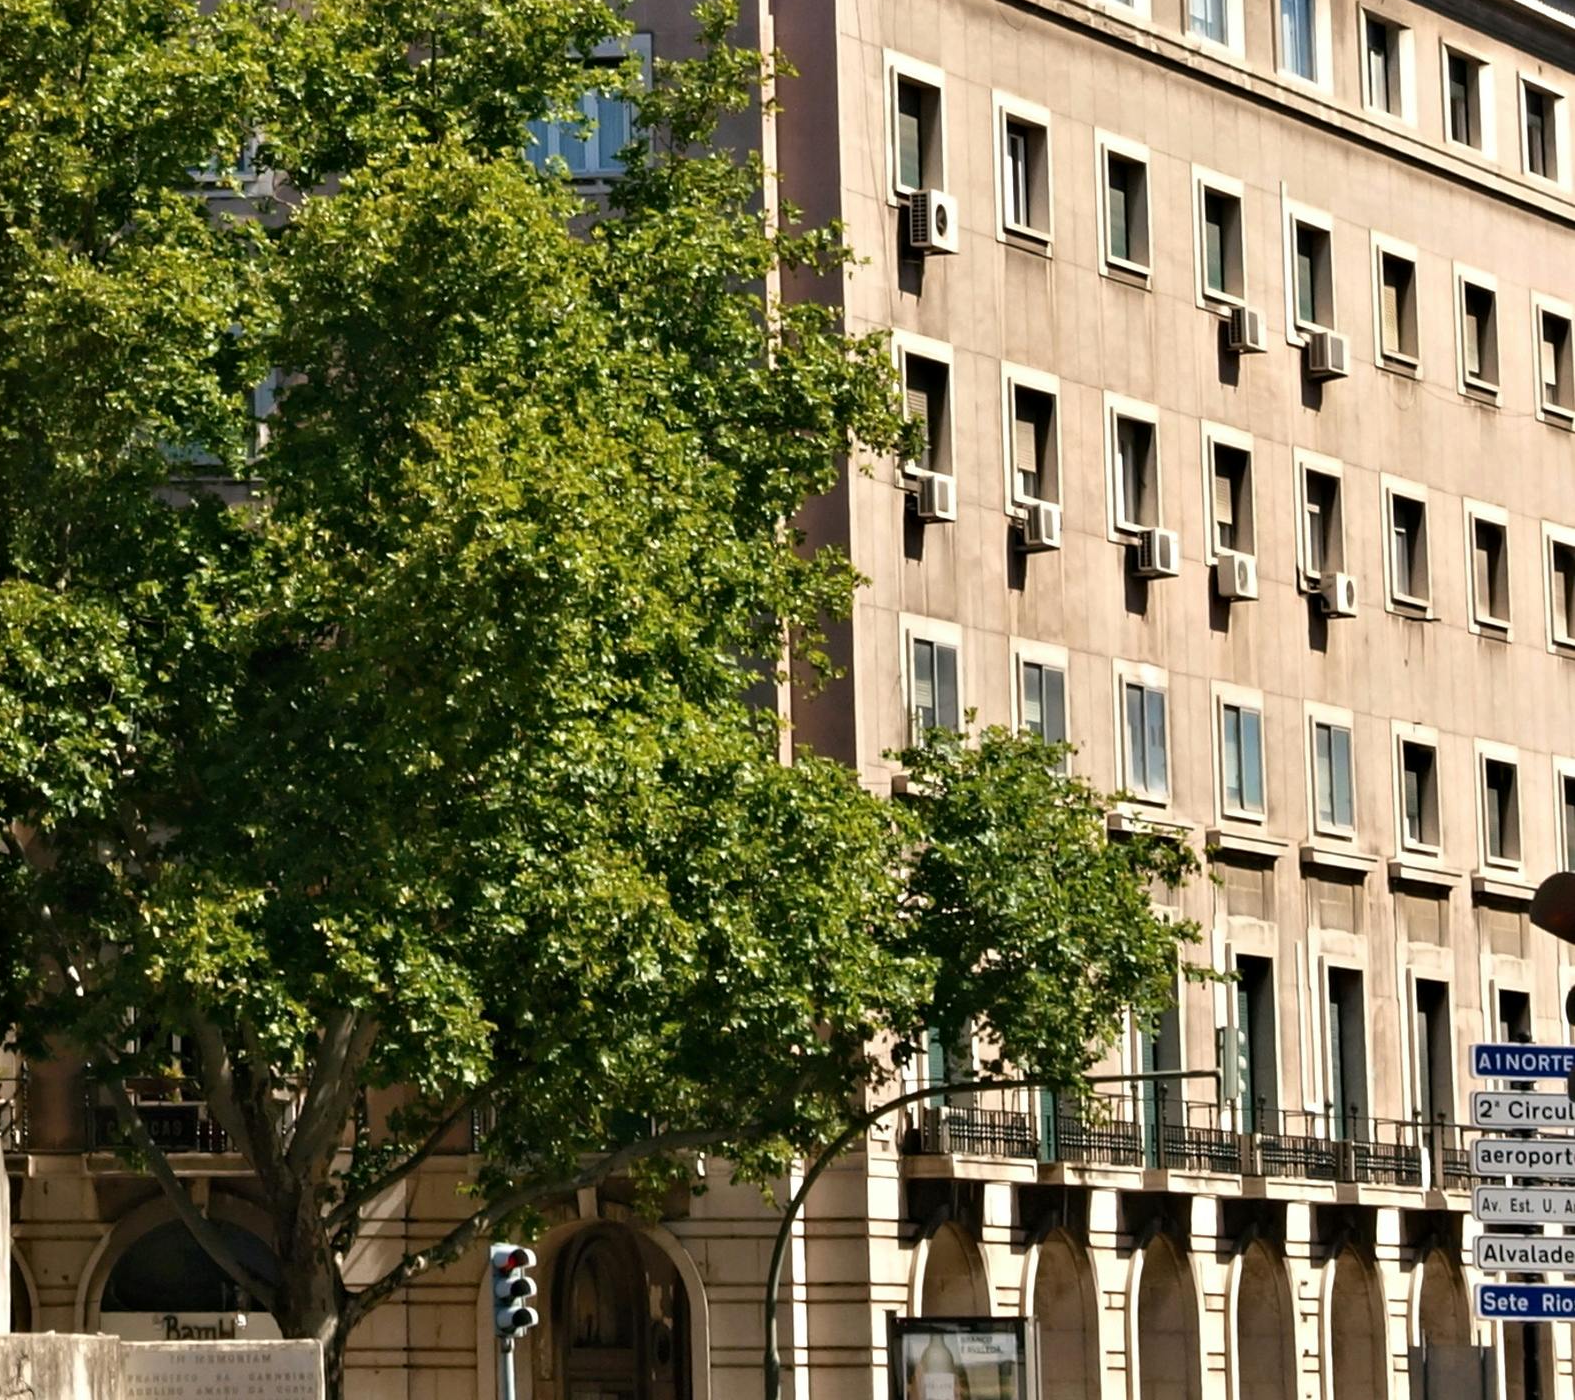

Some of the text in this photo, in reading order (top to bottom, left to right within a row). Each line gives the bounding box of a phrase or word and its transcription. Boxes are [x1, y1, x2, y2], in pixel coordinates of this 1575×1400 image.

[1480, 1147, 1575, 1168] aeroport
[1481, 1197, 1502, 1213] Av.
[1509, 1198, 1535, 1214] Est.
[1483, 1243, 1575, 1264] Alvalade
[1483, 1291, 1529, 1312] Sete
